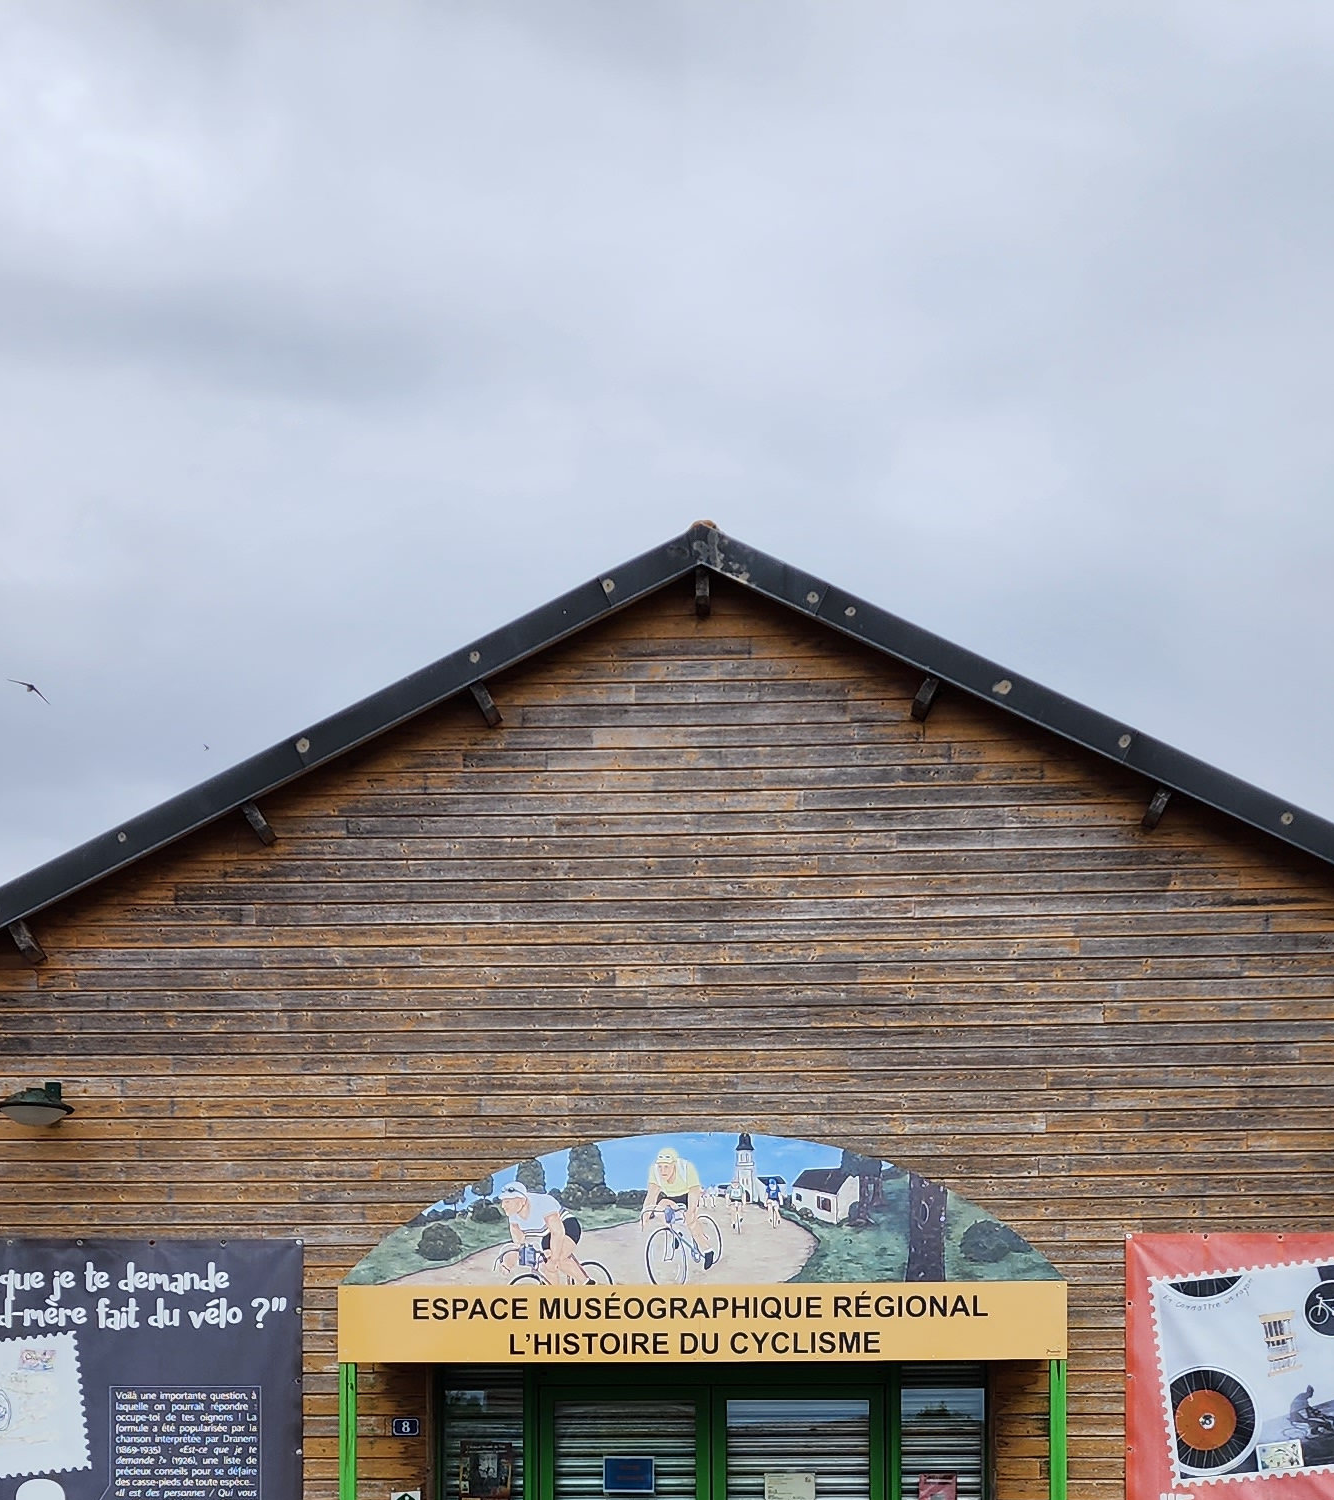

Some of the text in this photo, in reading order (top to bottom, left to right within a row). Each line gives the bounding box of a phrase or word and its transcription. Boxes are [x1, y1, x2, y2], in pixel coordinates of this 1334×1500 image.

[49, 1270, 76, 1301] je
[83, 1261, 110, 1292] te
[118, 1261, 230, 1295] demande
[1235, 1277, 1254, 1298] rayon
[96, 1297, 140, 1331] fait
[147, 1297, 181, 1329] du
[188, 1297, 243, 1329] vélo
[412, 1290, 989, 1320] ESPACE MUSÉOGRAPHIQUE RÉGIONAL
[509, 1331, 881, 1356] L’HISTOIRE DU CYCLISME
[401, 1420, 410, 1433] 8
